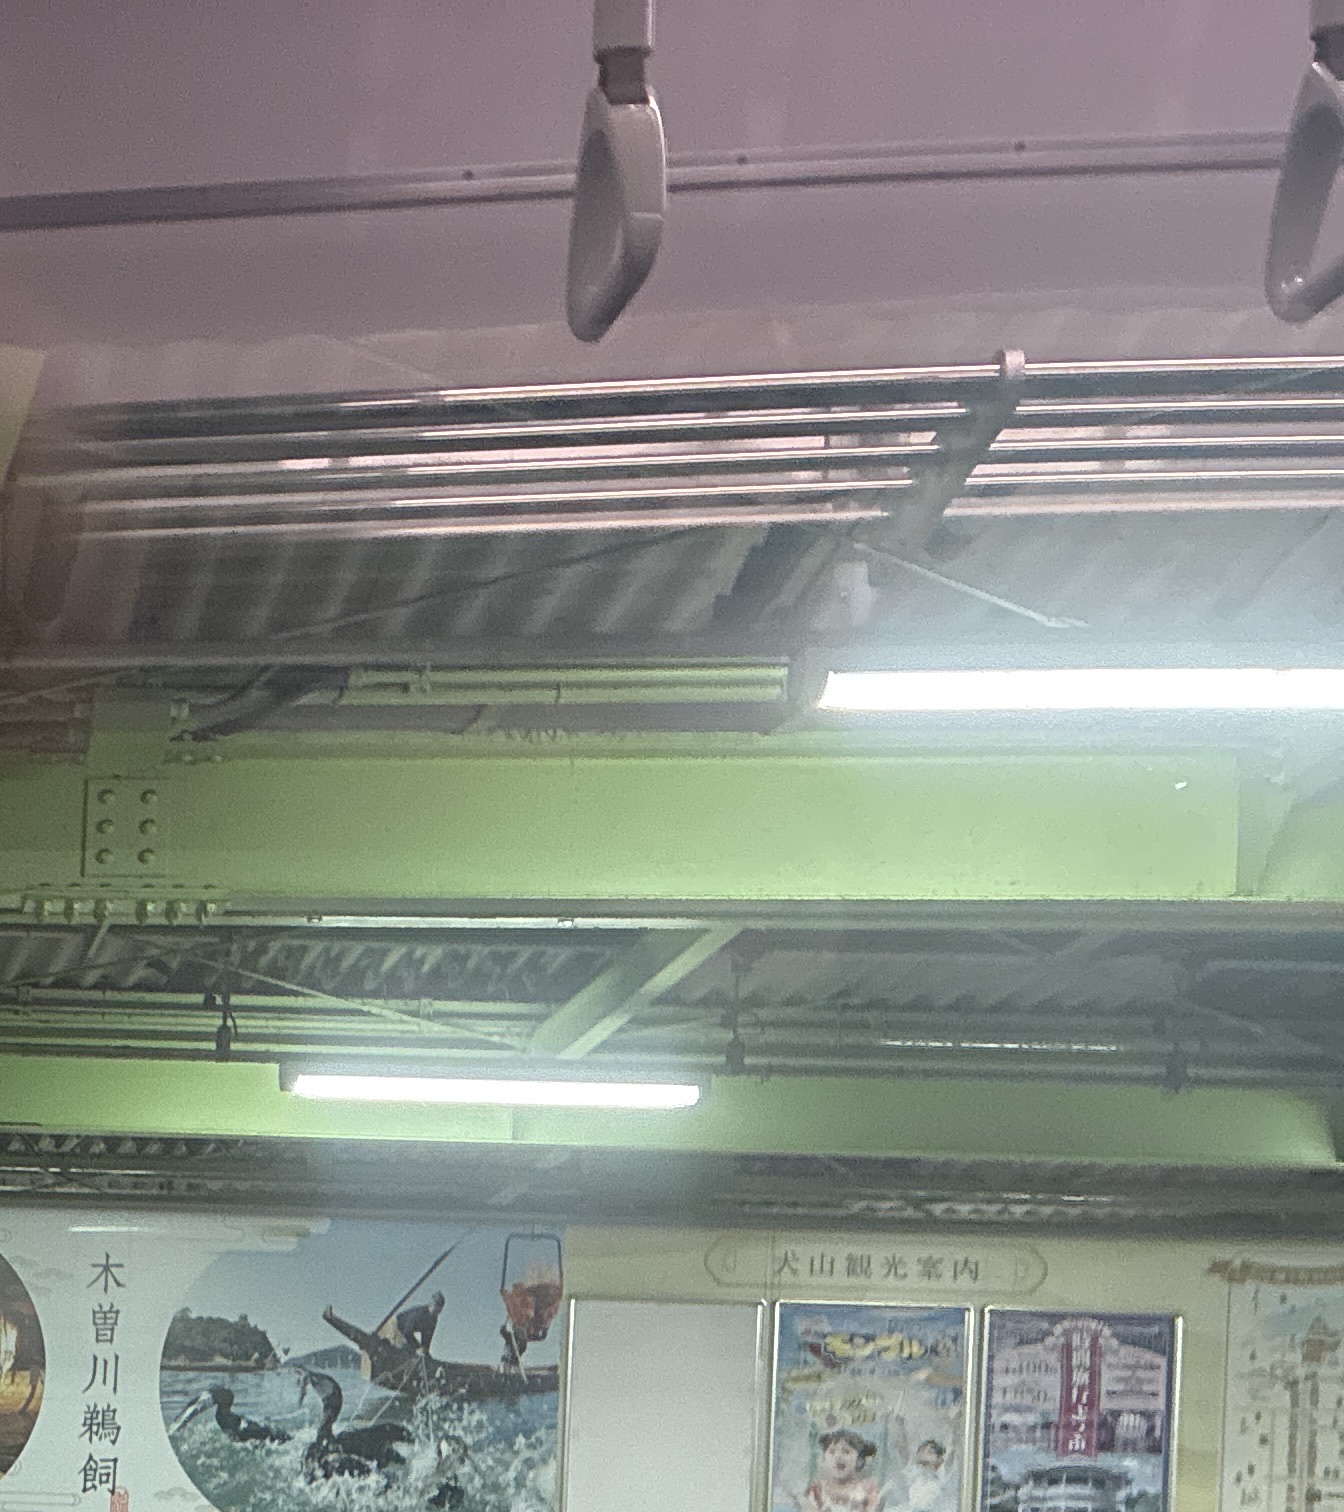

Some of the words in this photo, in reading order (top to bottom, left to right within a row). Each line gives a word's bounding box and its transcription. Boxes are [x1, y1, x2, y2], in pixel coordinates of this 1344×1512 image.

[777, 1249, 980, 1283] 犬山観光案内
[78, 1251, 127, 1496] 木曽川鵜飼
